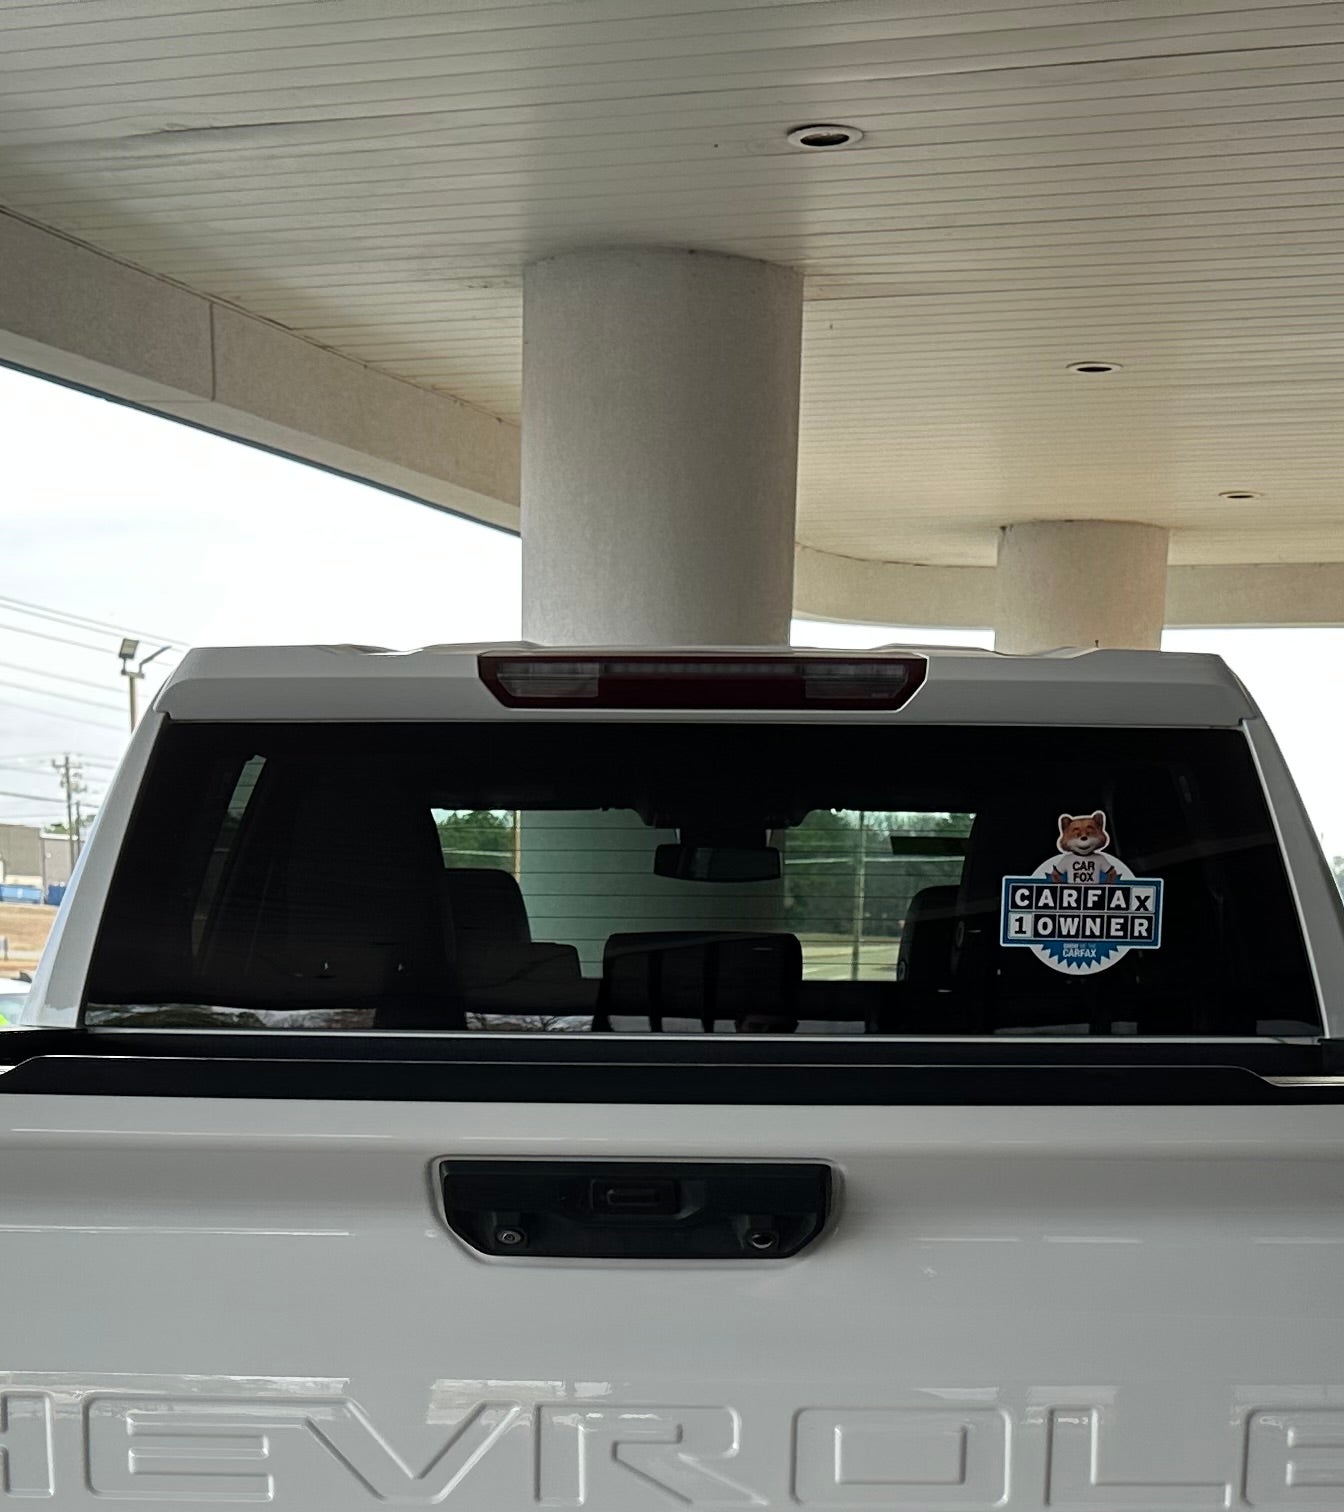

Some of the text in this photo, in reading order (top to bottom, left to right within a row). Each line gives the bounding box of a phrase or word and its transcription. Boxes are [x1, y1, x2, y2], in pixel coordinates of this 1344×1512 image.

[1072, 861, 1095, 872] CAR
[1073, 872, 1094, 882] FOX
[1014, 889, 1150, 911] CARFAX
[1037, 917, 1148, 937] OWNER
